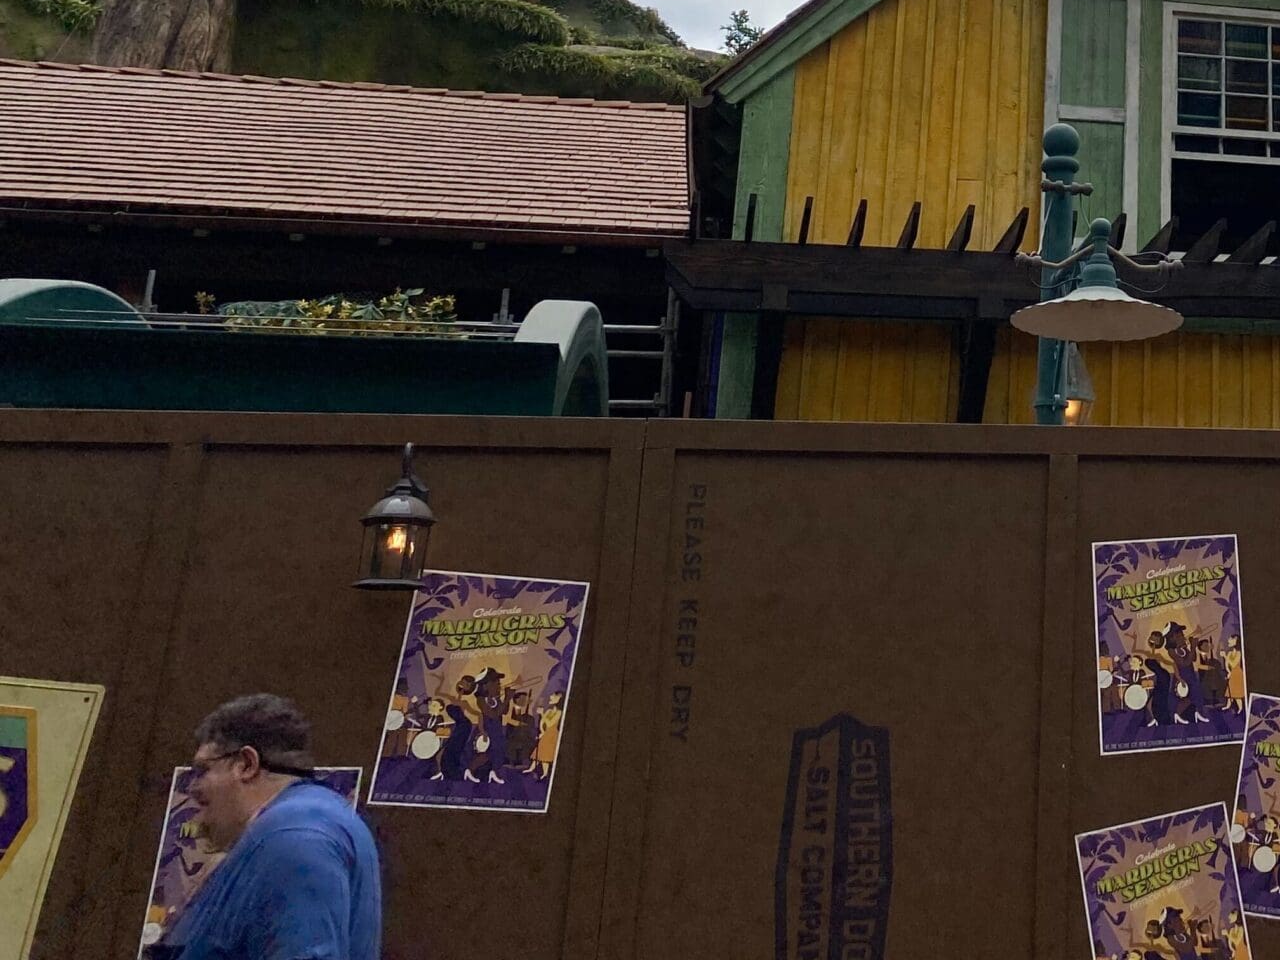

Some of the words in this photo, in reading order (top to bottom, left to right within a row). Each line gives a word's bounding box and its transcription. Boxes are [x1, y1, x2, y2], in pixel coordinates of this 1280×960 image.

[681, 483, 707, 582] PLEASE
[1105, 576, 1170, 600] MARDI
[1173, 565, 1225, 588] GRAS
[1130, 580, 1207, 612] SEASON
[421, 617, 499, 636] MARDI
[503, 613, 566, 632] GRAS
[445, 629, 542, 651] SEASON
[675, 598, 698, 667] KEEP
[670, 685, 692, 742] DRY
[803, 766, 831, 835] SALT
[844, 738, 882, 908] SOUTHERN
[1096, 858, 1161, 895] MARDI
[1163, 837, 1218, 868] GRAS
[1120, 856, 1201, 903] SEASON
[1135, 842, 1176, 865] Celebrate
